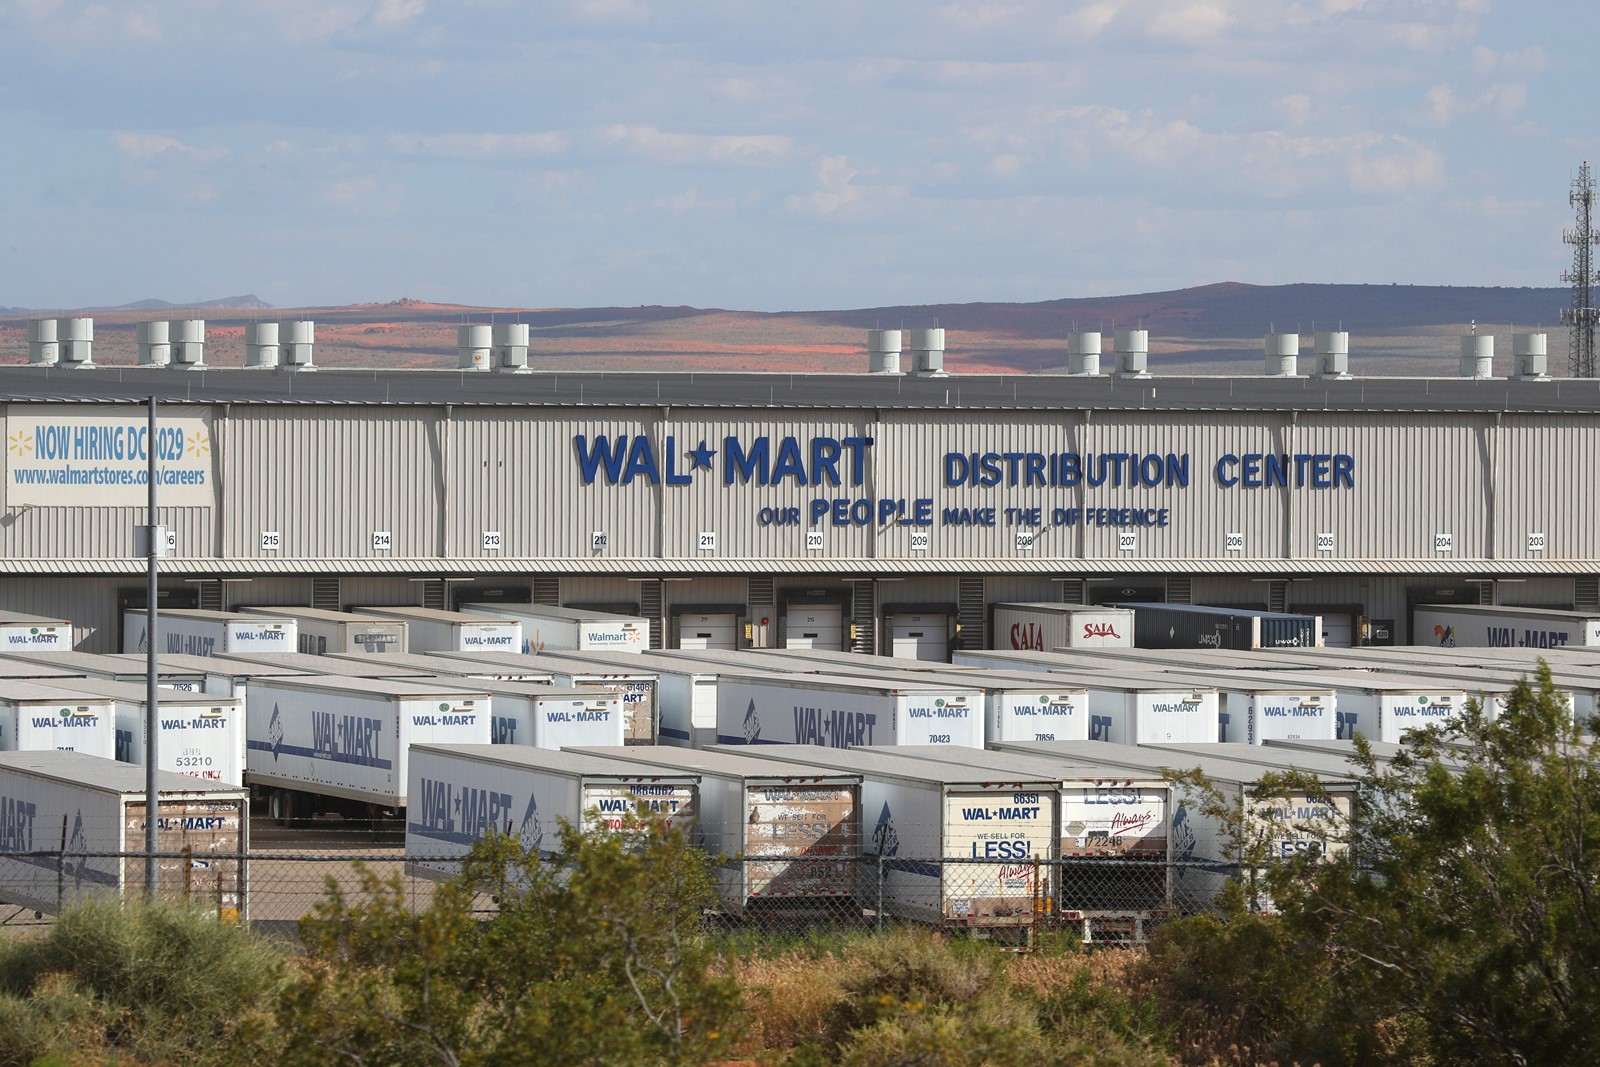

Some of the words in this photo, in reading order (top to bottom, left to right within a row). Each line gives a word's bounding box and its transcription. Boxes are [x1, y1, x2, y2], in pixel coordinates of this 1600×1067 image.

[35, 425, 71, 460] NOW
[74, 426, 124, 461] HIRING
[127, 426, 147, 461] DC
[947, 452, 1190, 487] DISTRIBUTION
[1217, 453, 1355, 488] CENTER
[760, 507, 801, 525] OUR
[812, 498, 933, 526] PEOPLE
[944, 507, 997, 526] MAKE
[1005, 507, 1042, 526] THE
[1054, 507, 1169, 526] DIFFERENCE
[263, 535, 279, 546] 215
[374, 535, 390, 546] 214
[484, 535, 500, 546] 213
[593, 535, 607, 546] 212
[700, 535, 714, 546] 211
[808, 535, 822, 546] 210
[912, 535, 928, 546] 209
[1017, 535, 1033, 546] 208
[1120, 535, 1136, 546] 207
[1226, 536, 1243, 547] 206
[1318, 536, 1334, 547] 205
[1436, 537, 1452, 548] 204
[1528, 536, 1545, 547] 203
[588, 632, 627, 641] Walmart
[1083, 622, 1121, 640] SAIA
[172, 683, 192, 692] 71526
[928, 734, 951, 744] 70423
[176, 757, 212, 767] 53210
[1013, 793, 1039, 804] 66351
[990, 832, 1009, 840] SELL
[1011, 832, 1026, 840] FOR
[1087, 835, 1123, 847] 72248
[972, 840, 1032, 859] LESS!
